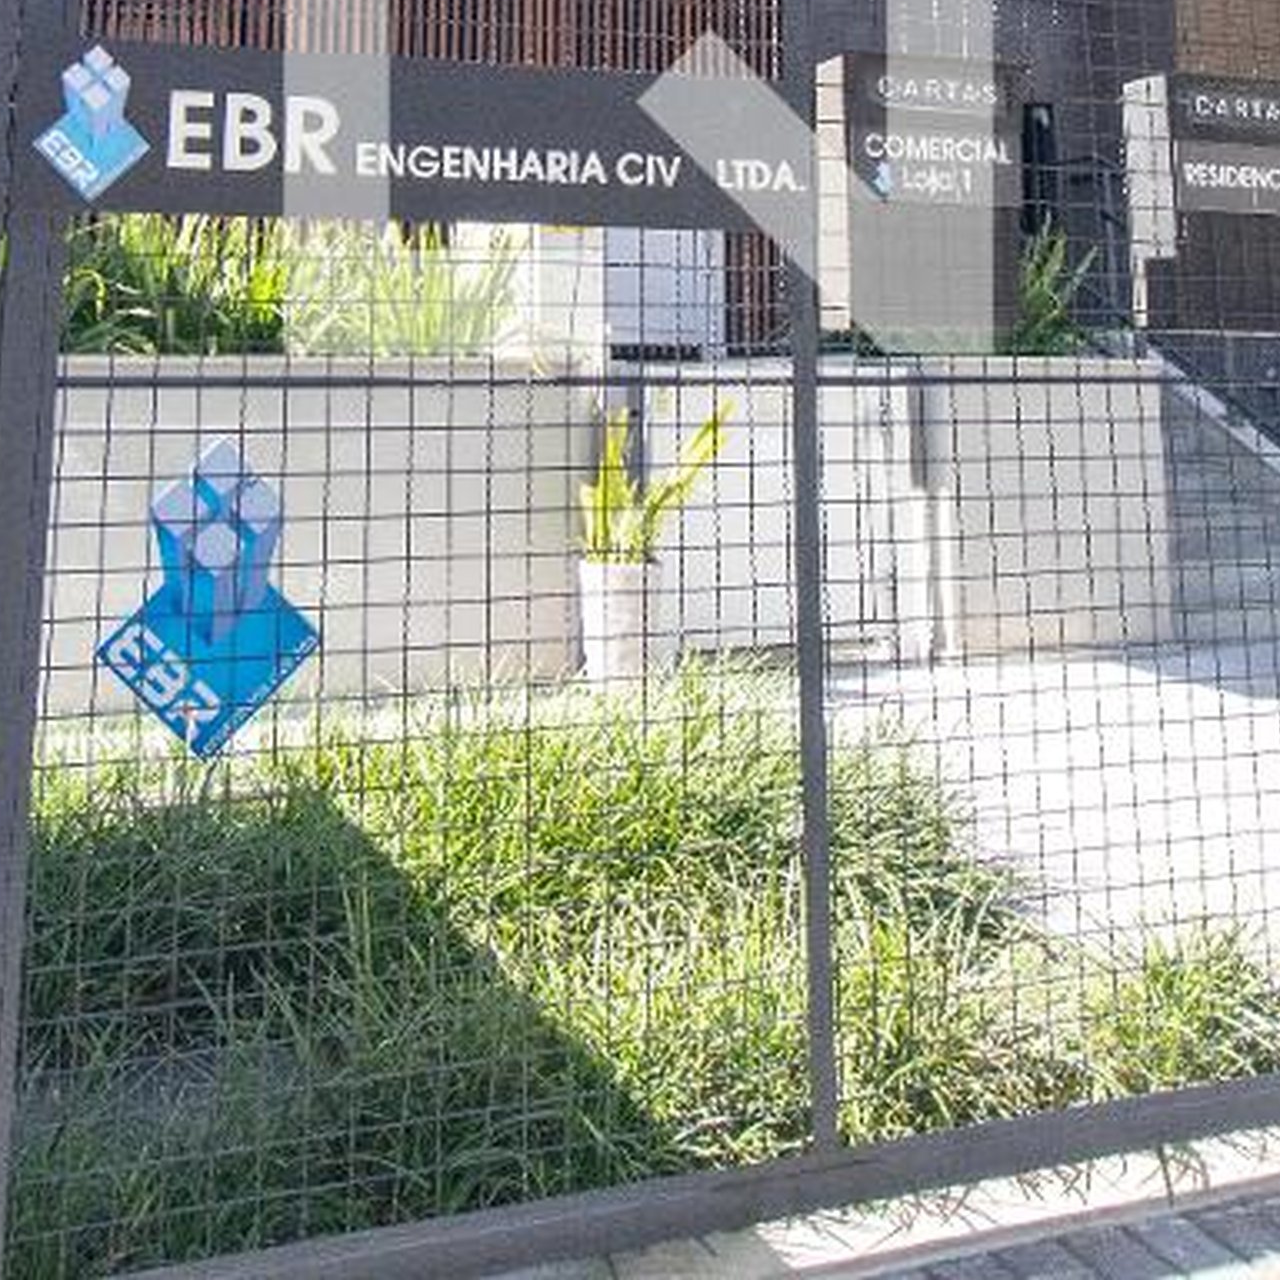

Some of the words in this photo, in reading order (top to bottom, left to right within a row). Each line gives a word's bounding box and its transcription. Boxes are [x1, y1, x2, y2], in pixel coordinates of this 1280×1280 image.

[877, 76, 998, 105] CARTAS
[42, 129, 101, 189] EBR
[166, 89, 341, 175] EBR
[355, 142, 608, 186] ENGENHARIA
[716, 158, 808, 192] LTDA.
[864, 133, 1013, 165] COMERCIAL
